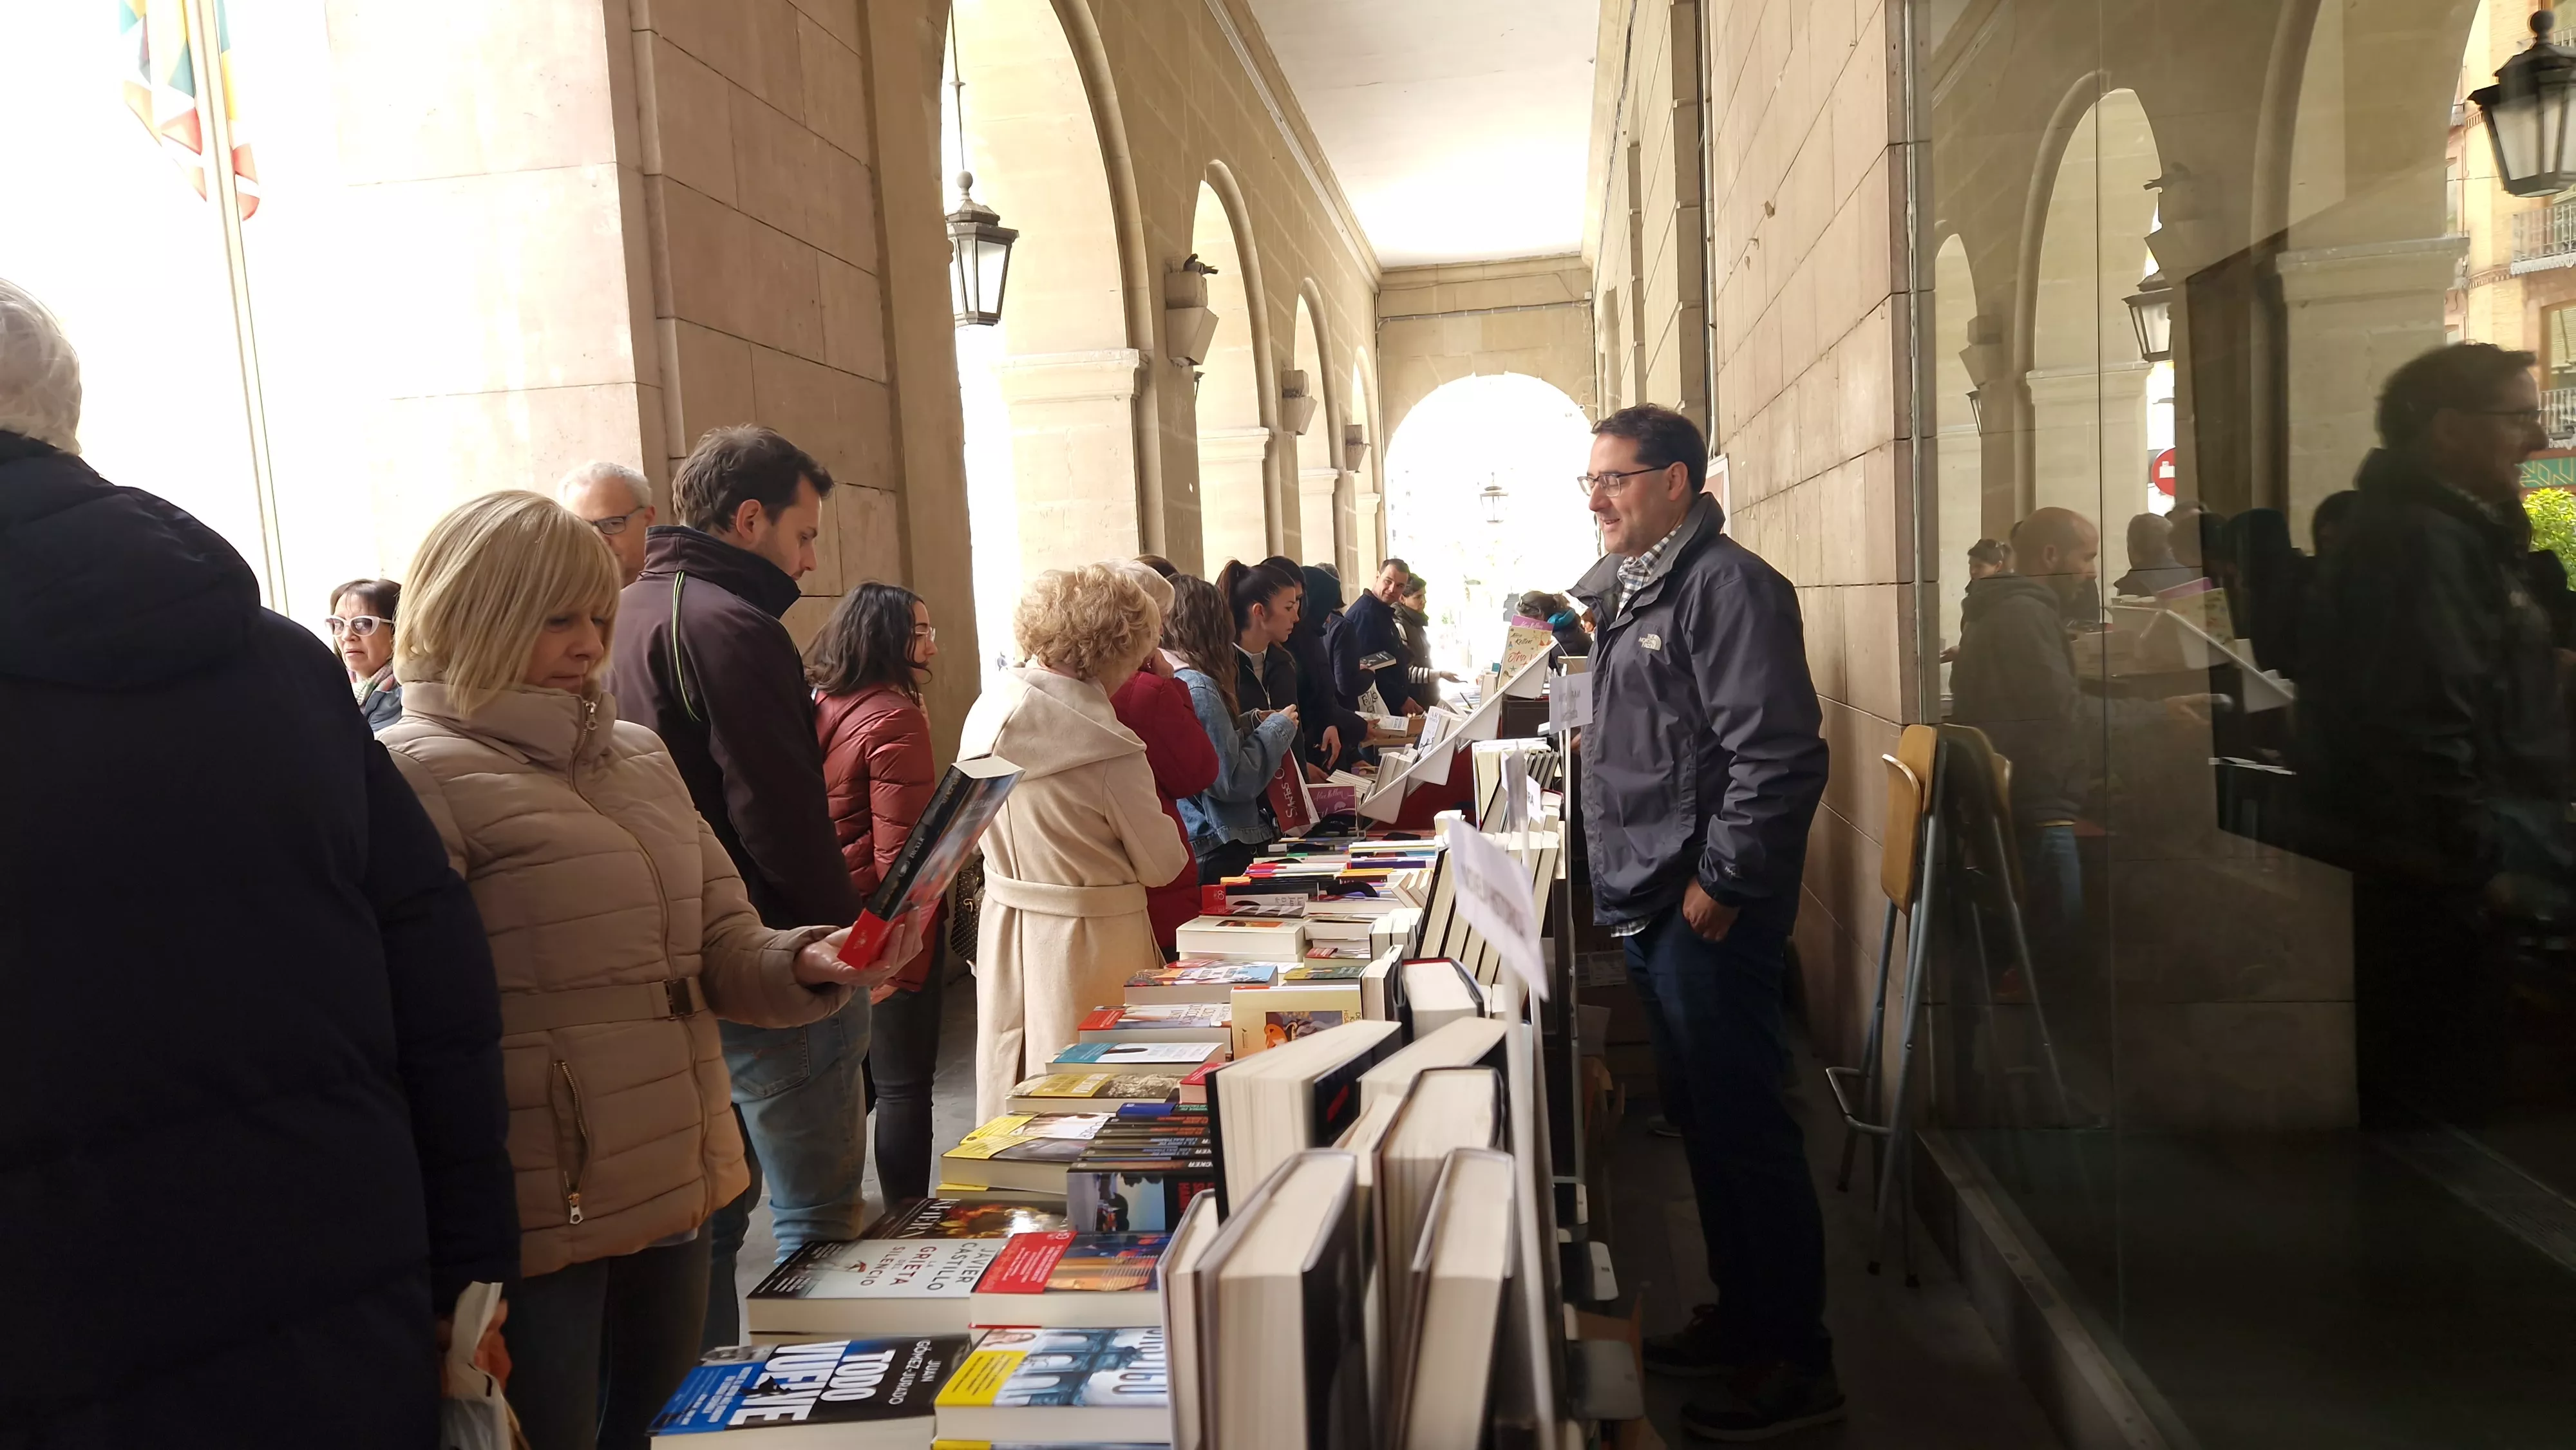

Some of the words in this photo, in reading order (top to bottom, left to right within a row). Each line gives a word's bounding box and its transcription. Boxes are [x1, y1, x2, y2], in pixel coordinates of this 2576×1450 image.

[896, 1198, 961, 1238] INFIERN
[860, 1247, 906, 1286] SILENCIO
[889, 1246, 937, 1286] GRIETA
[891, 1259, 906, 1270] DEL
[927, 1242, 978, 1291] CASTILLO
[955, 1247, 996, 1284] JAVIER
[820, 1349, 896, 1402] TODO
[887, 1339, 933, 1405] GÓMEZ-JURADO
[920, 1359, 942, 1382] JUAN
